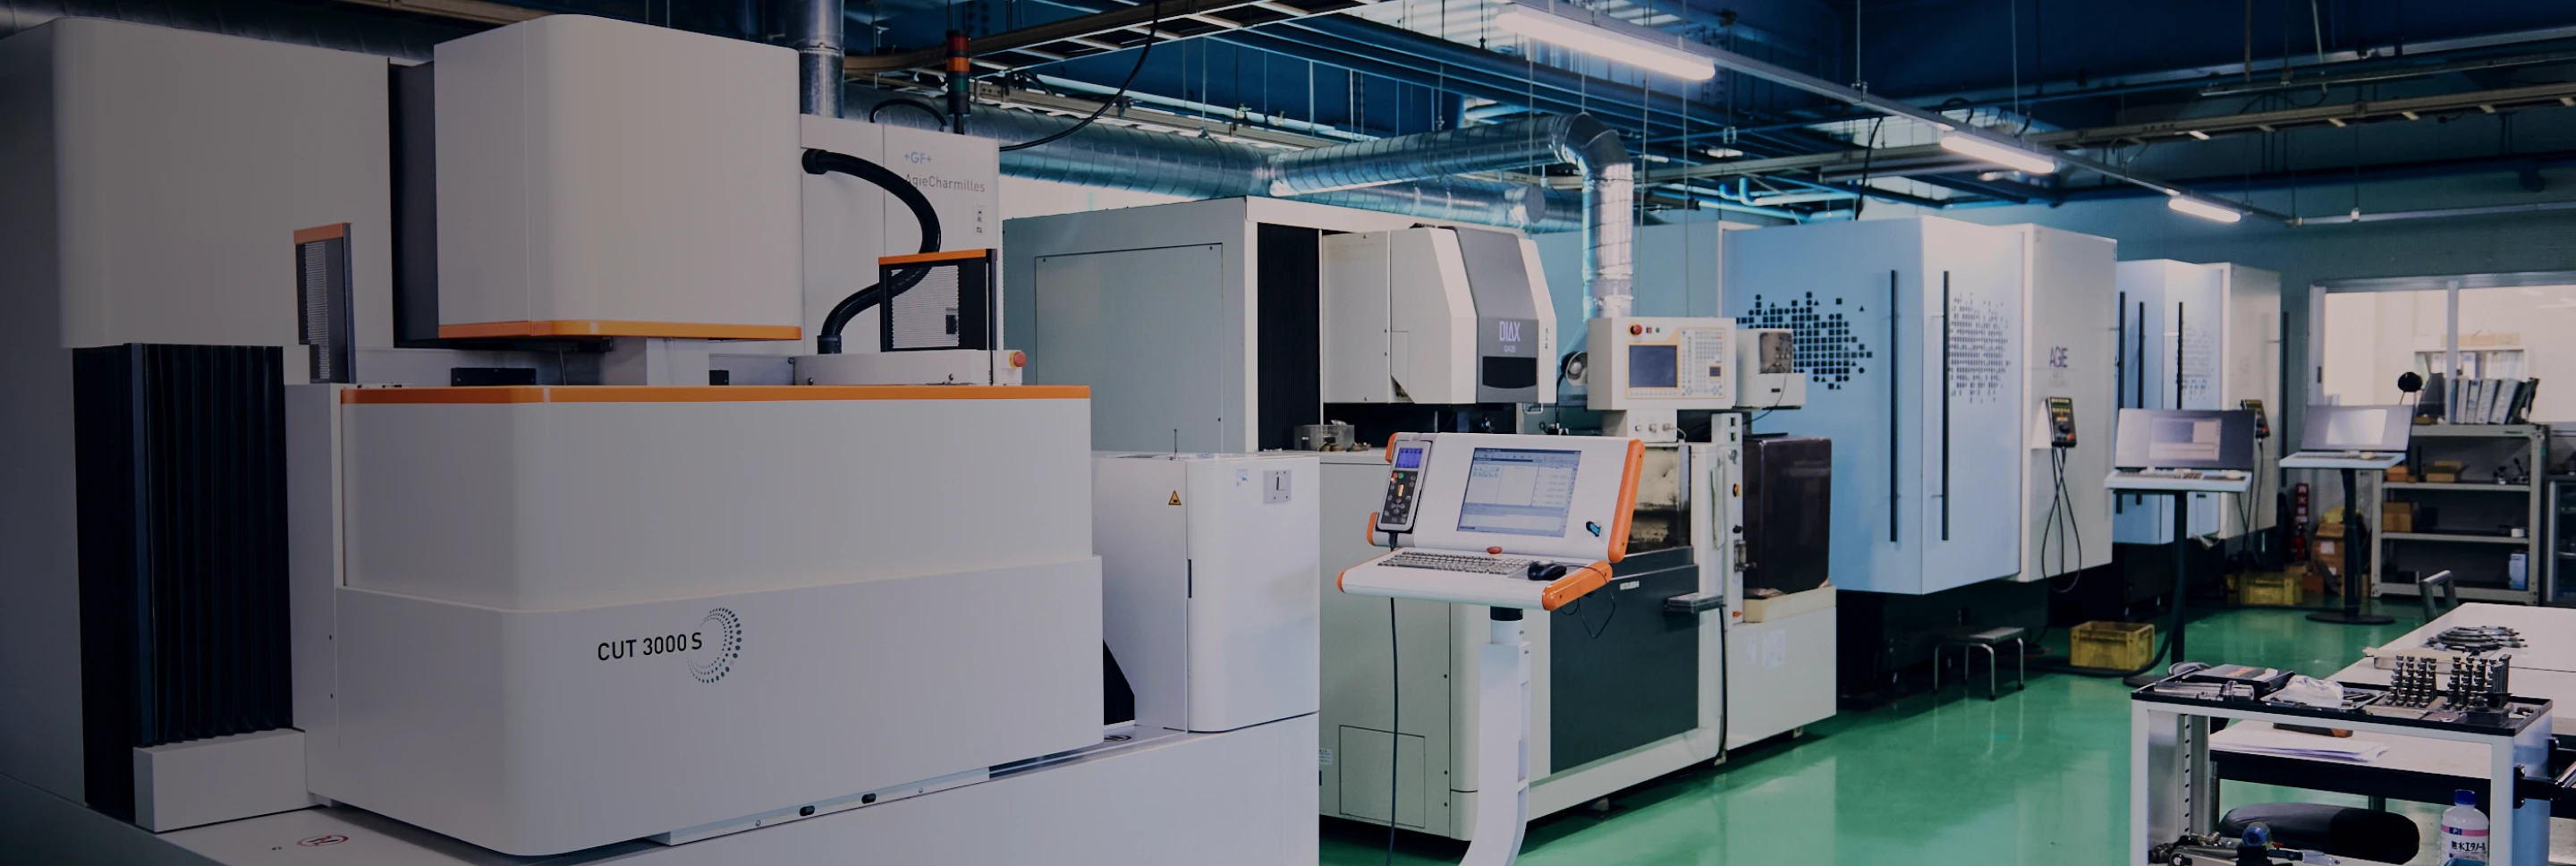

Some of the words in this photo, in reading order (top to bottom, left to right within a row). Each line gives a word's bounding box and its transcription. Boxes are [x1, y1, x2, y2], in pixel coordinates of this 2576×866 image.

[905, 174, 986, 193] AgieCharmilles
[1499, 321, 1521, 342] DIAX
[2049, 345, 2068, 369] AGIE
[597, 639, 637, 661] CUT
[642, 633, 687, 656] 3000
[691, 632, 703, 650] S
